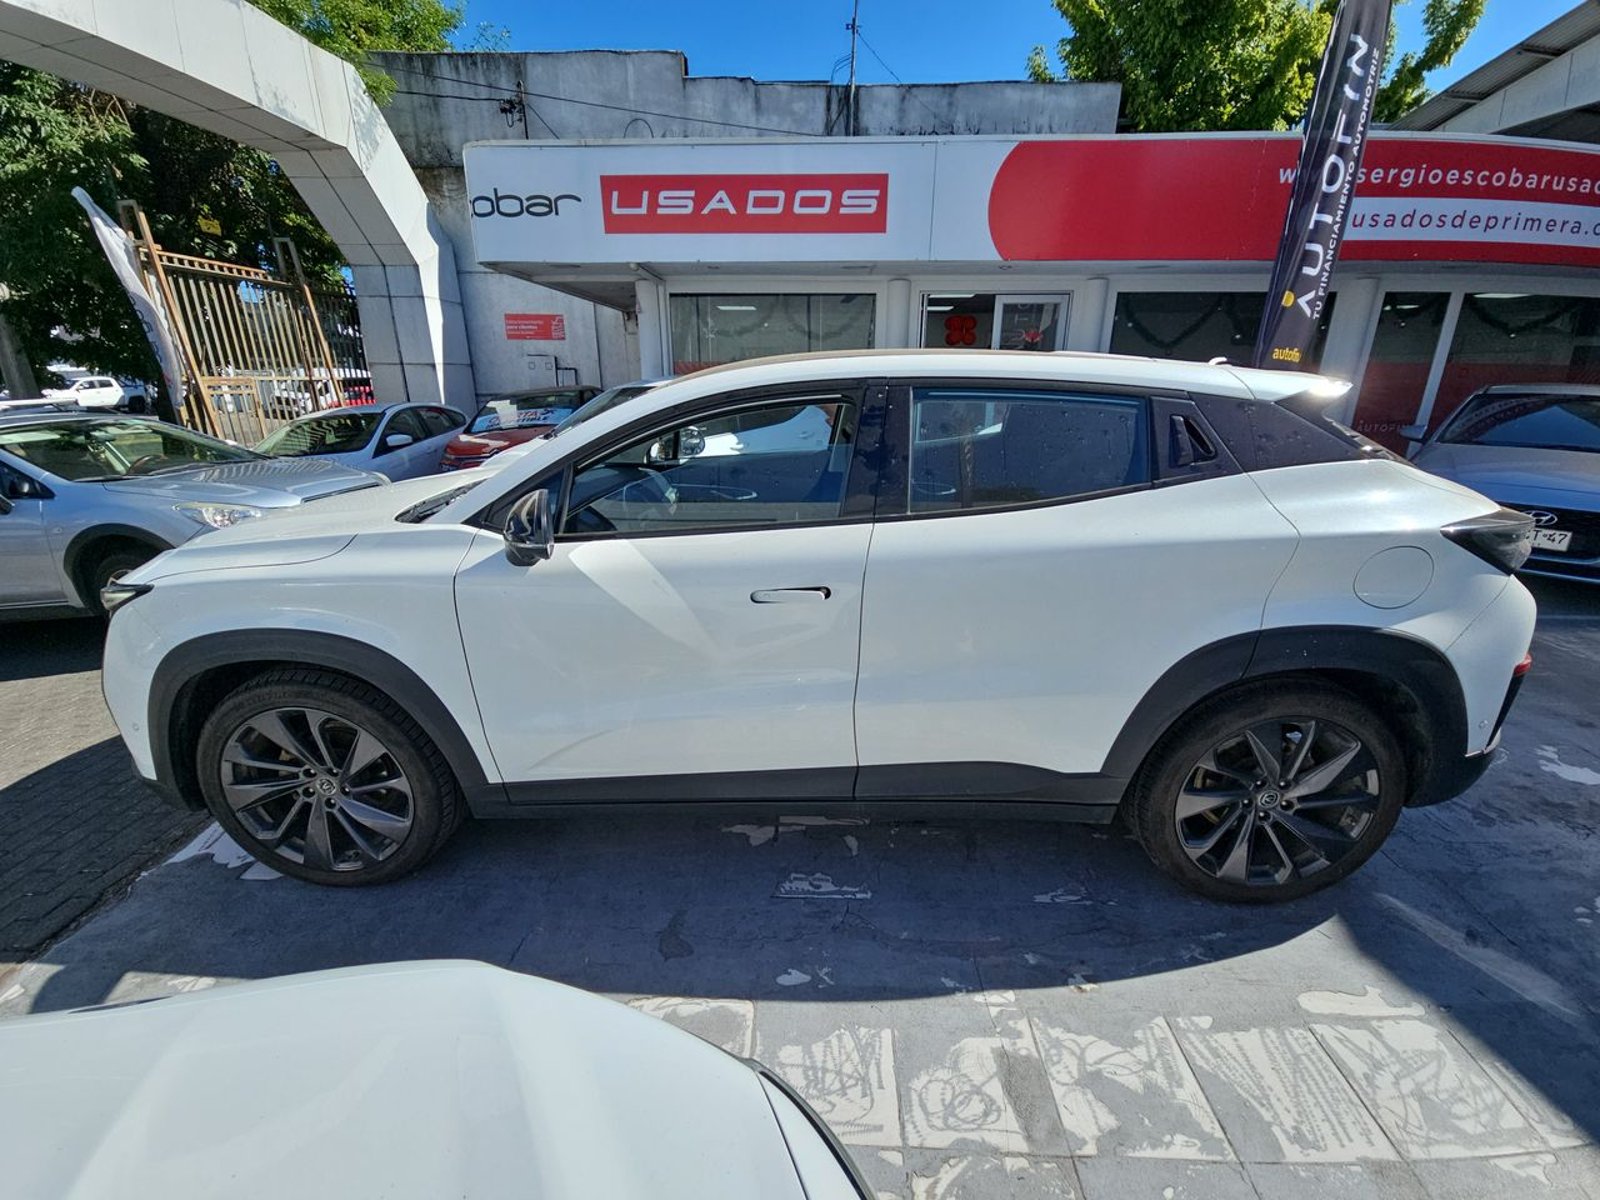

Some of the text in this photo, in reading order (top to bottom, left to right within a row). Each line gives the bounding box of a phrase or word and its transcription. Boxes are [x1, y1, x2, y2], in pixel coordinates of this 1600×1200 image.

[470, 187, 582, 218] obar
[611, 189, 880, 215] USADOS
[1296, 33, 1368, 318] AUTOFIN
[1313, 48, 1380, 320] TU FINANCIAMIENTO AUTOMOTRIZ
